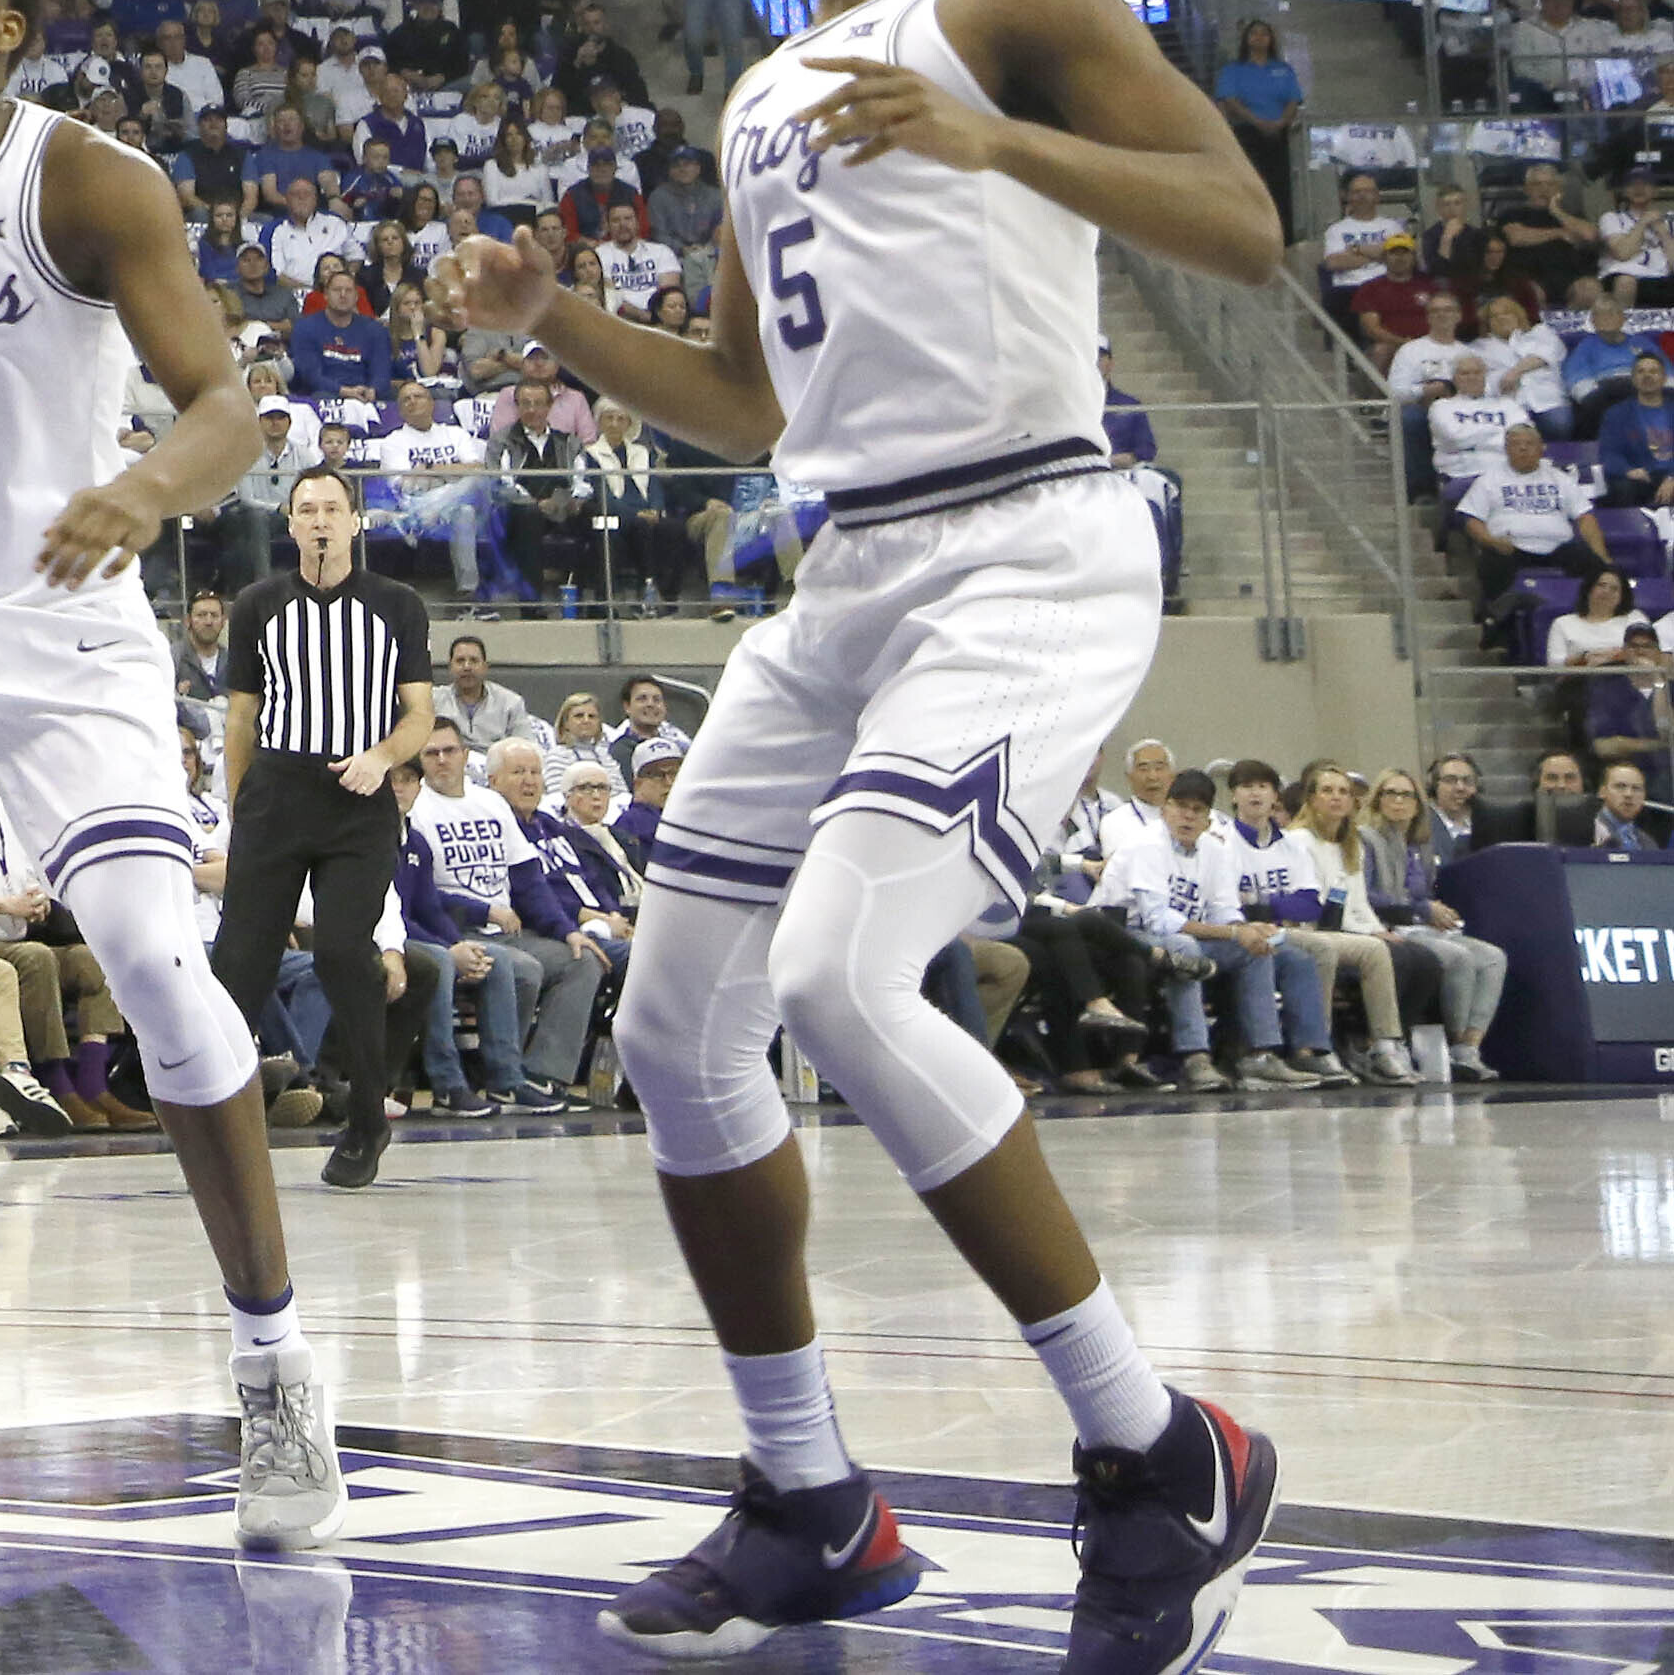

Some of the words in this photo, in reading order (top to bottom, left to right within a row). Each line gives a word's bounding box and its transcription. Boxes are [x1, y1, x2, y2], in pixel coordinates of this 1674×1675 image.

[725, 83, 871, 193] Frog
[768, 215, 828, 353] 5
[435, 818, 502, 845] BLEED
